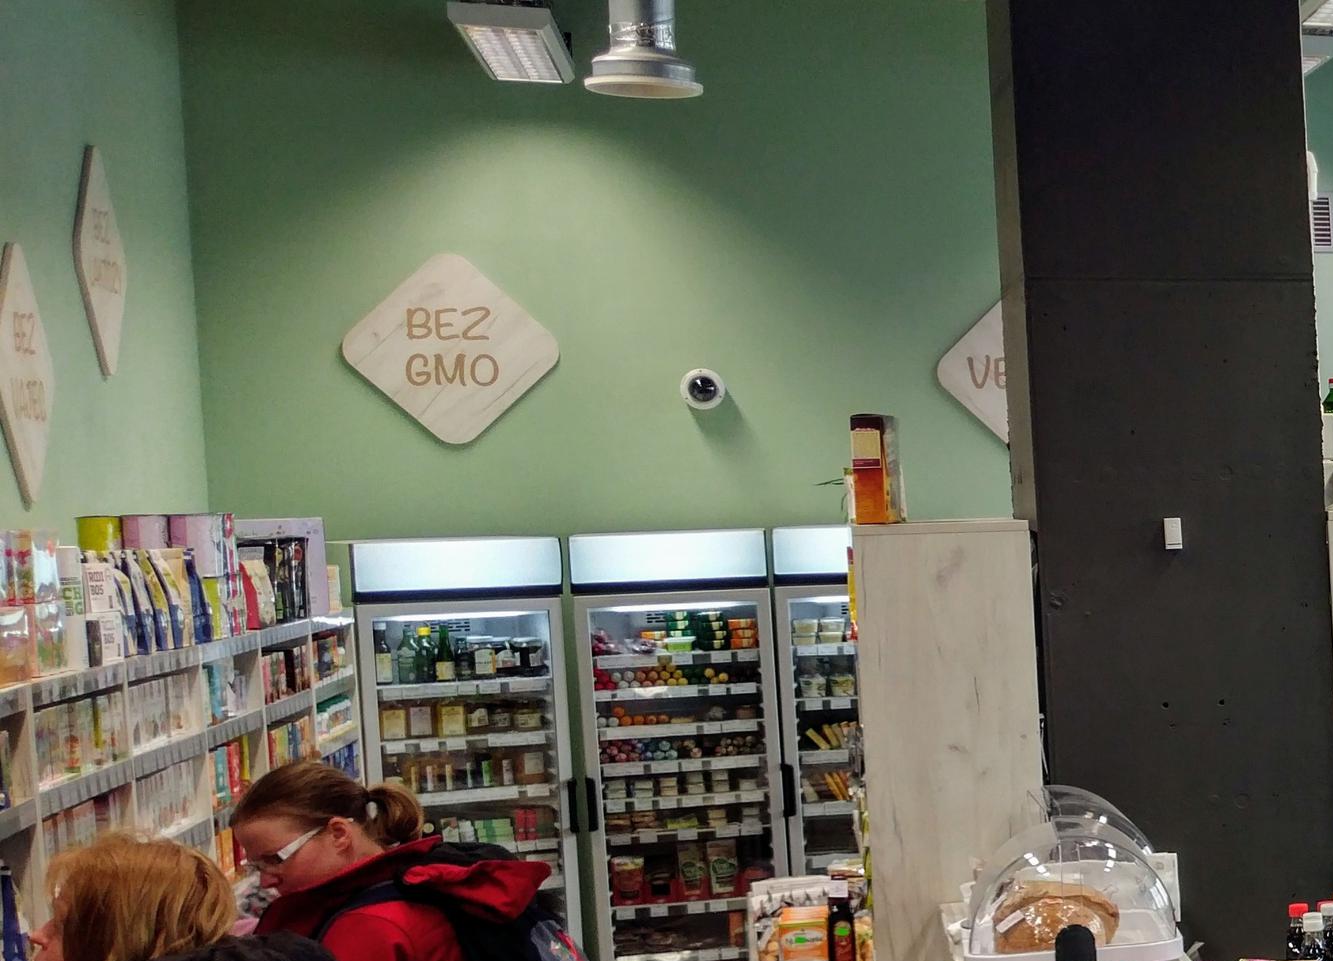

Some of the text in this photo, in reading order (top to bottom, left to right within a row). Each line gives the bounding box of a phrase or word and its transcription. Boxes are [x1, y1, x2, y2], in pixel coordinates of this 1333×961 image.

[13, 311, 36, 355] BEZ
[406, 306, 491, 341] BEZ
[405, 353, 499, 387] GMO
